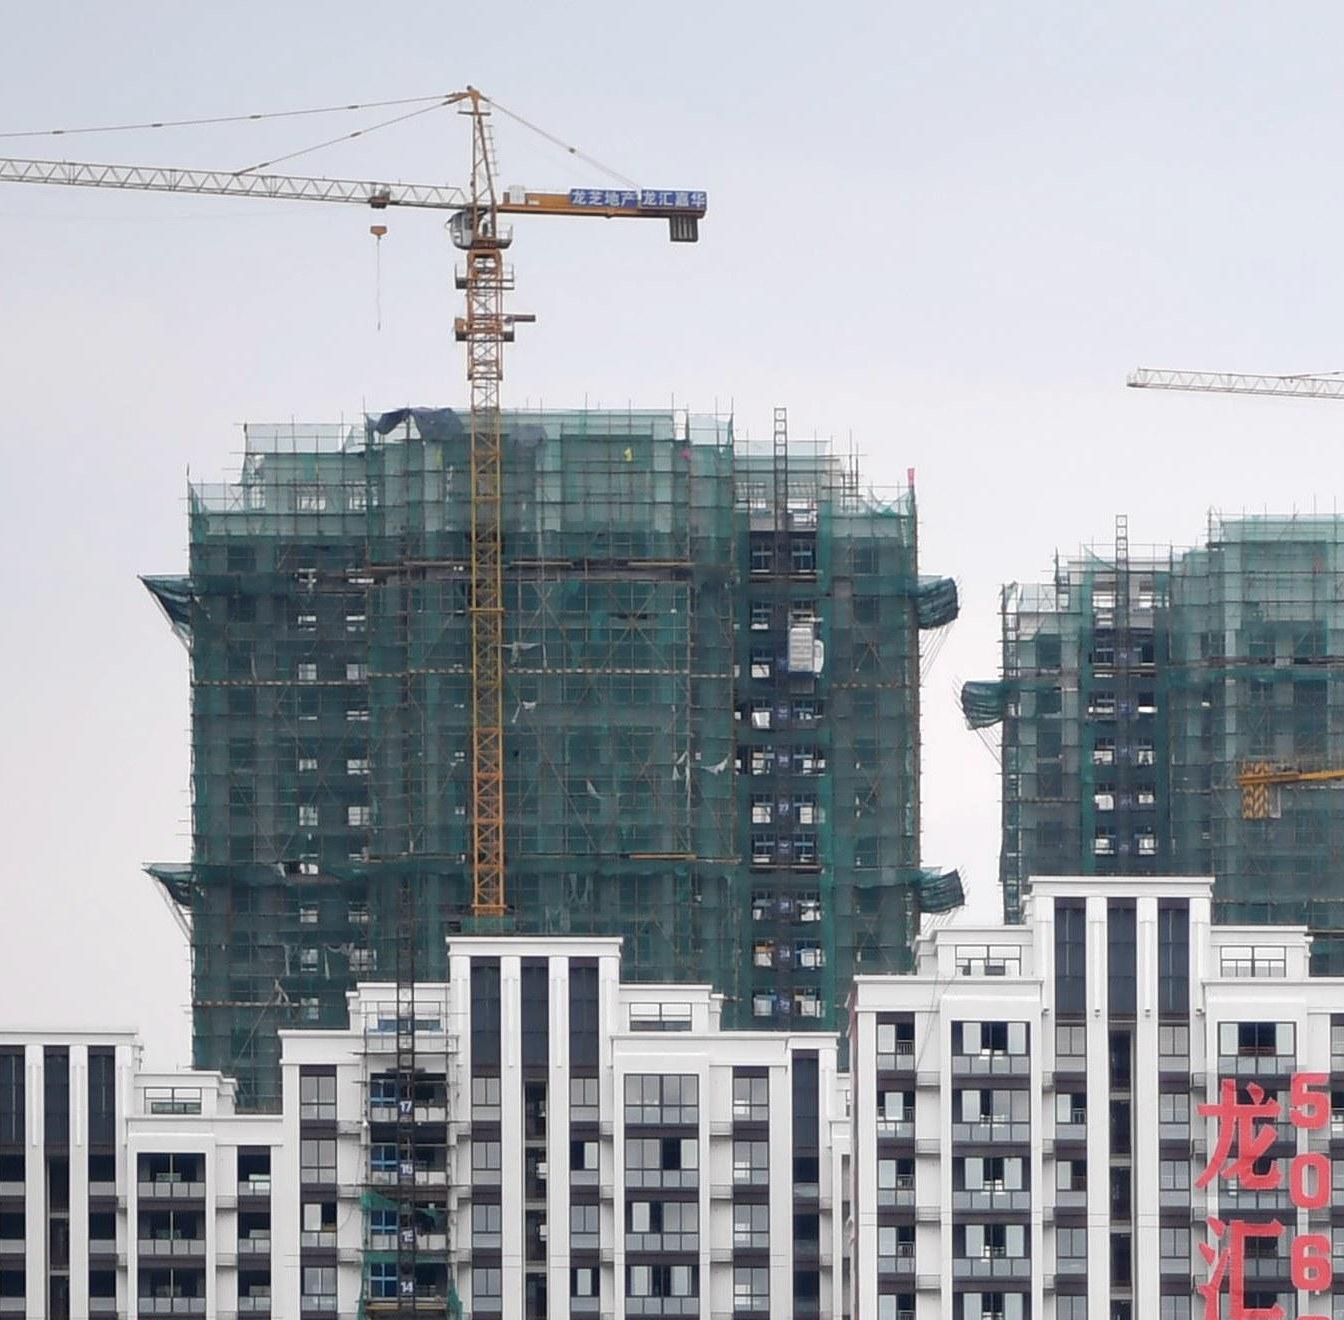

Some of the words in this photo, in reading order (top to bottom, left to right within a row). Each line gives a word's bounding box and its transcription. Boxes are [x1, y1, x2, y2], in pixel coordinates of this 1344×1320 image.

[572, 190, 638, 207] 龙芝地产
[643, 190, 706, 207] 龙汇嘉华
